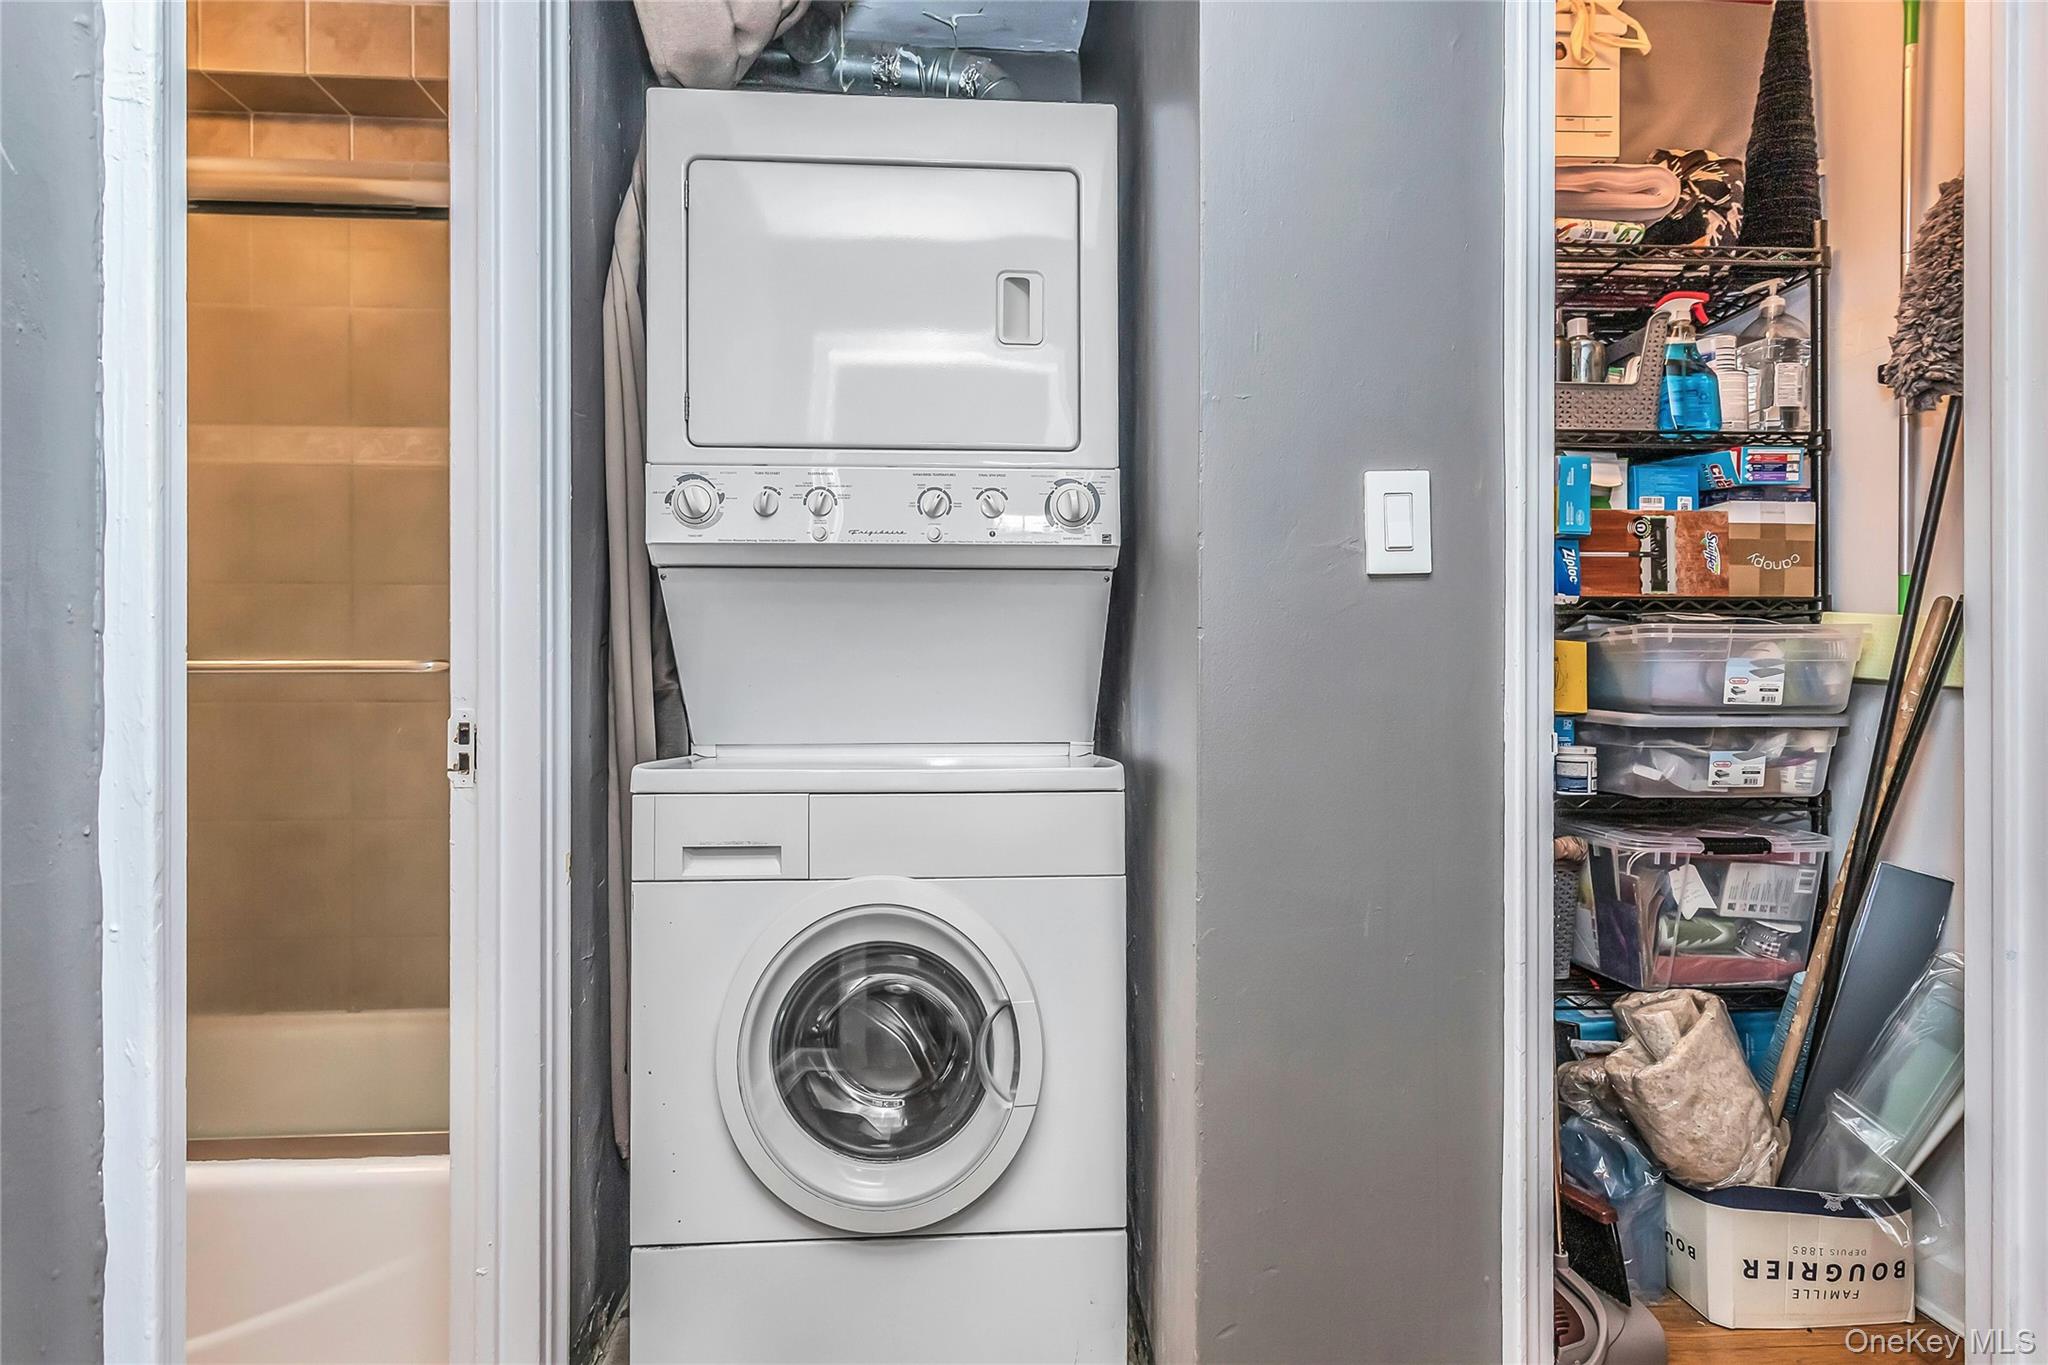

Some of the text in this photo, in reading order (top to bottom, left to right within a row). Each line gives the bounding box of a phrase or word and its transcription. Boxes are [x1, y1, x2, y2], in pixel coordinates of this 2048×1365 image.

[1703, 532, 1718, 573] Swiffer
[1747, 553, 1800, 571] canopy
[1561, 548, 1578, 584] Ziploc
[1792, 1245, 1867, 1257] DEPUIS 1885
[1742, 1259, 1906, 1282] BOUGRIER
[1791, 1289, 1860, 1300] FAMILLE
